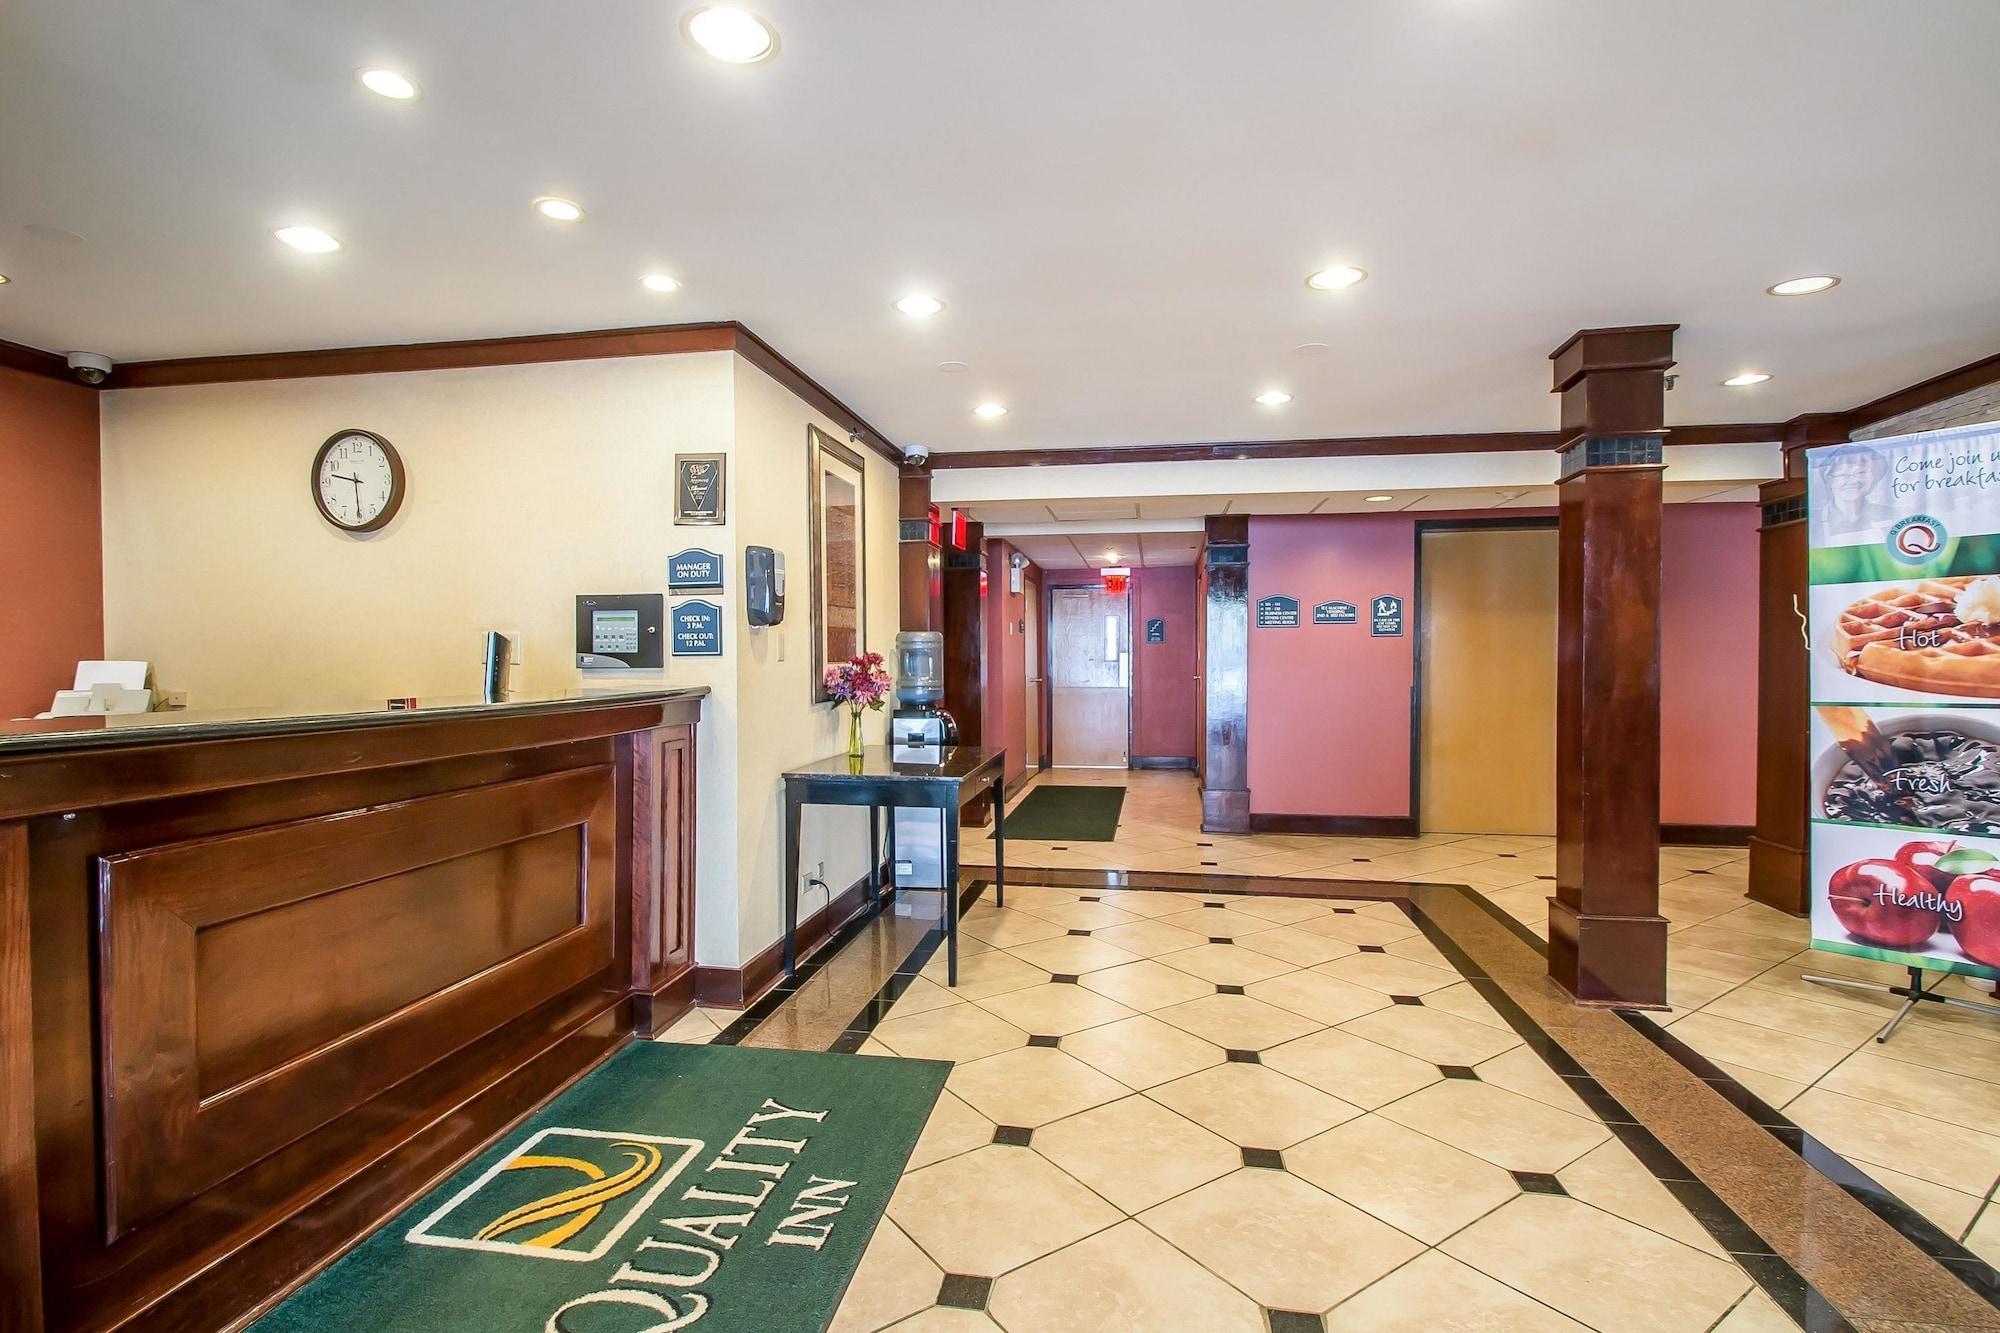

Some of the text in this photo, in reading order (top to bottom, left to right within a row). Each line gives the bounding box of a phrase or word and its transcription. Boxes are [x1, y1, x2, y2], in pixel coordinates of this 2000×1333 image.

[339, 447, 348, 459] 11
[352, 441, 363, 453] 12
[330, 460, 339, 472] 10
[378, 456, 385, 468] 2
[1895, 456, 1944, 474] Come
[1946, 450, 1983, 474] join
[325, 479, 331, 488] 9
[384, 474, 391, 485] 3
[1892, 467, 2000, 498] for breakfa
[330, 495, 337, 505] 8
[379, 491, 387, 502] 4
[369, 503, 376, 515] 5
[1896, 515, 1941, 529] BREAKFAST
[1896, 525, 1941, 555] Q
[676, 562, 711, 571] MANAGER
[677, 570, 689, 578] ON
[699, 632, 714, 640] OUT:
[1895, 627, 1941, 649] Hot
[1882, 767, 1953, 793] Fresh
[1873, 883, 1963, 921] Healthy
[545, 1098, 831, 1333] QUALITY
[764, 1175, 859, 1251] INN
